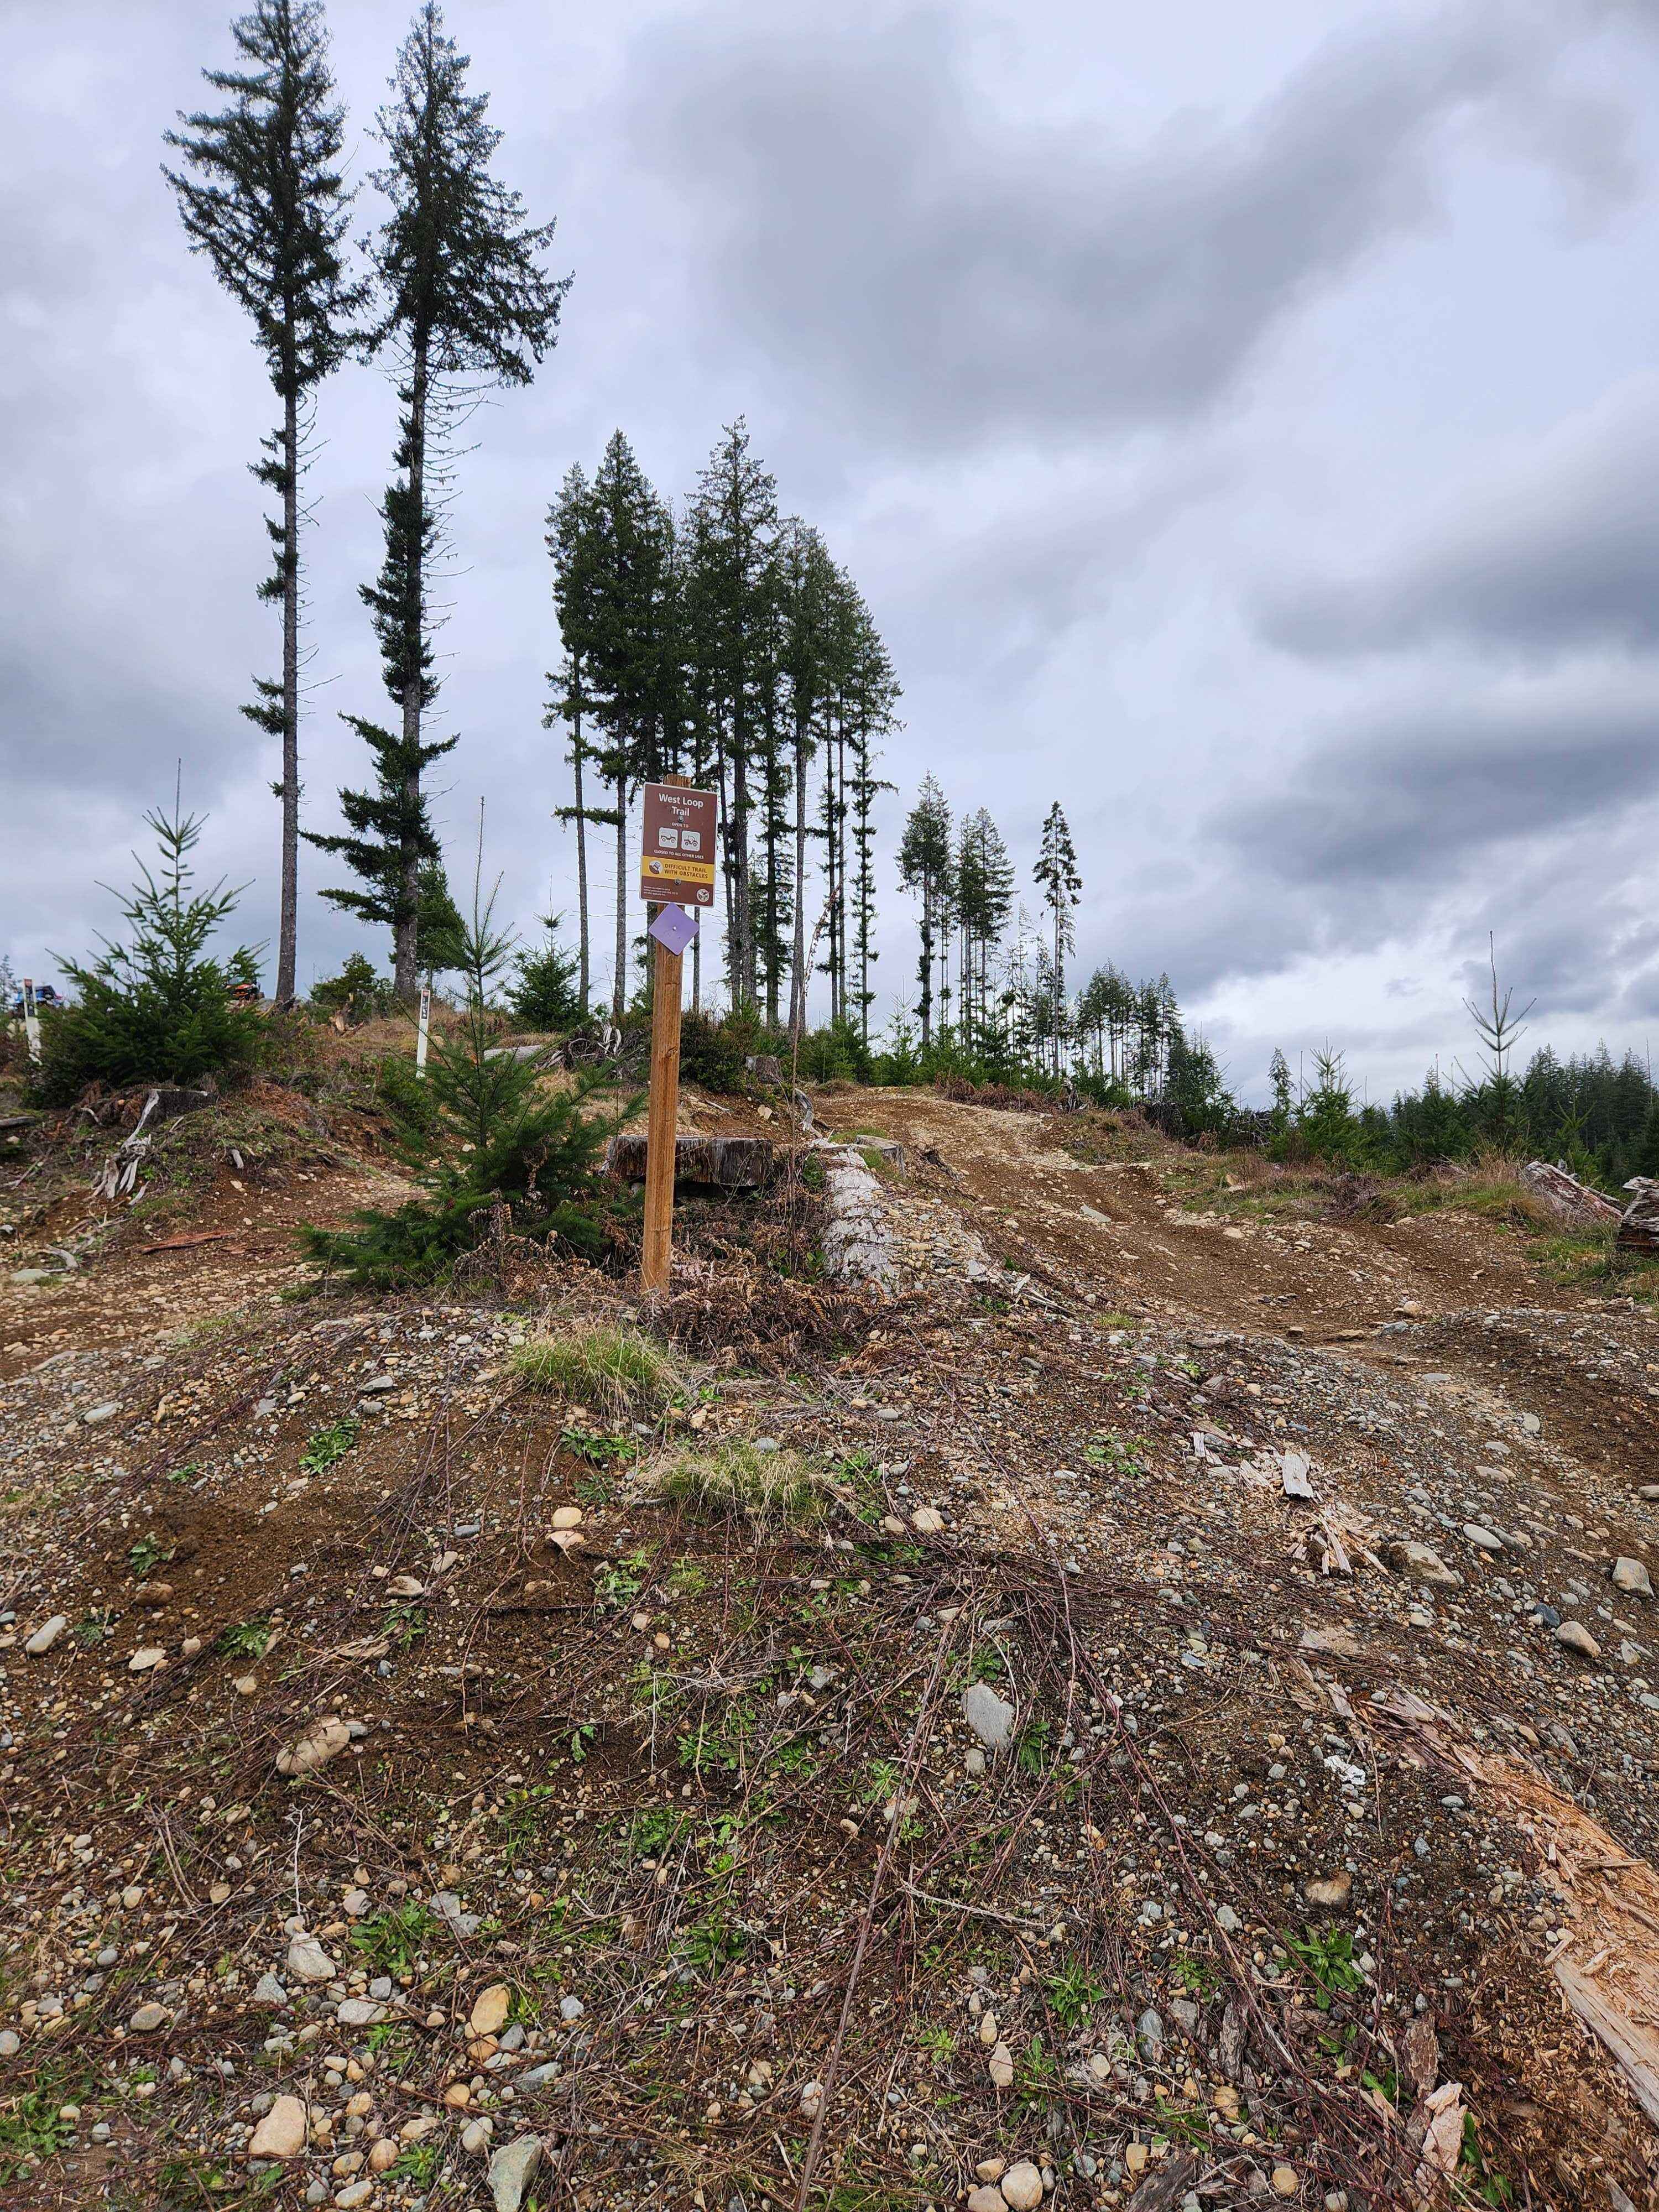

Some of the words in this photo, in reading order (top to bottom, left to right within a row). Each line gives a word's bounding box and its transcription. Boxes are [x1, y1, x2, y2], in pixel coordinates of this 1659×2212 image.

[659, 793, 681, 804] West
[682, 797, 703, 808] Loop
[672, 806, 690, 816] Trail
